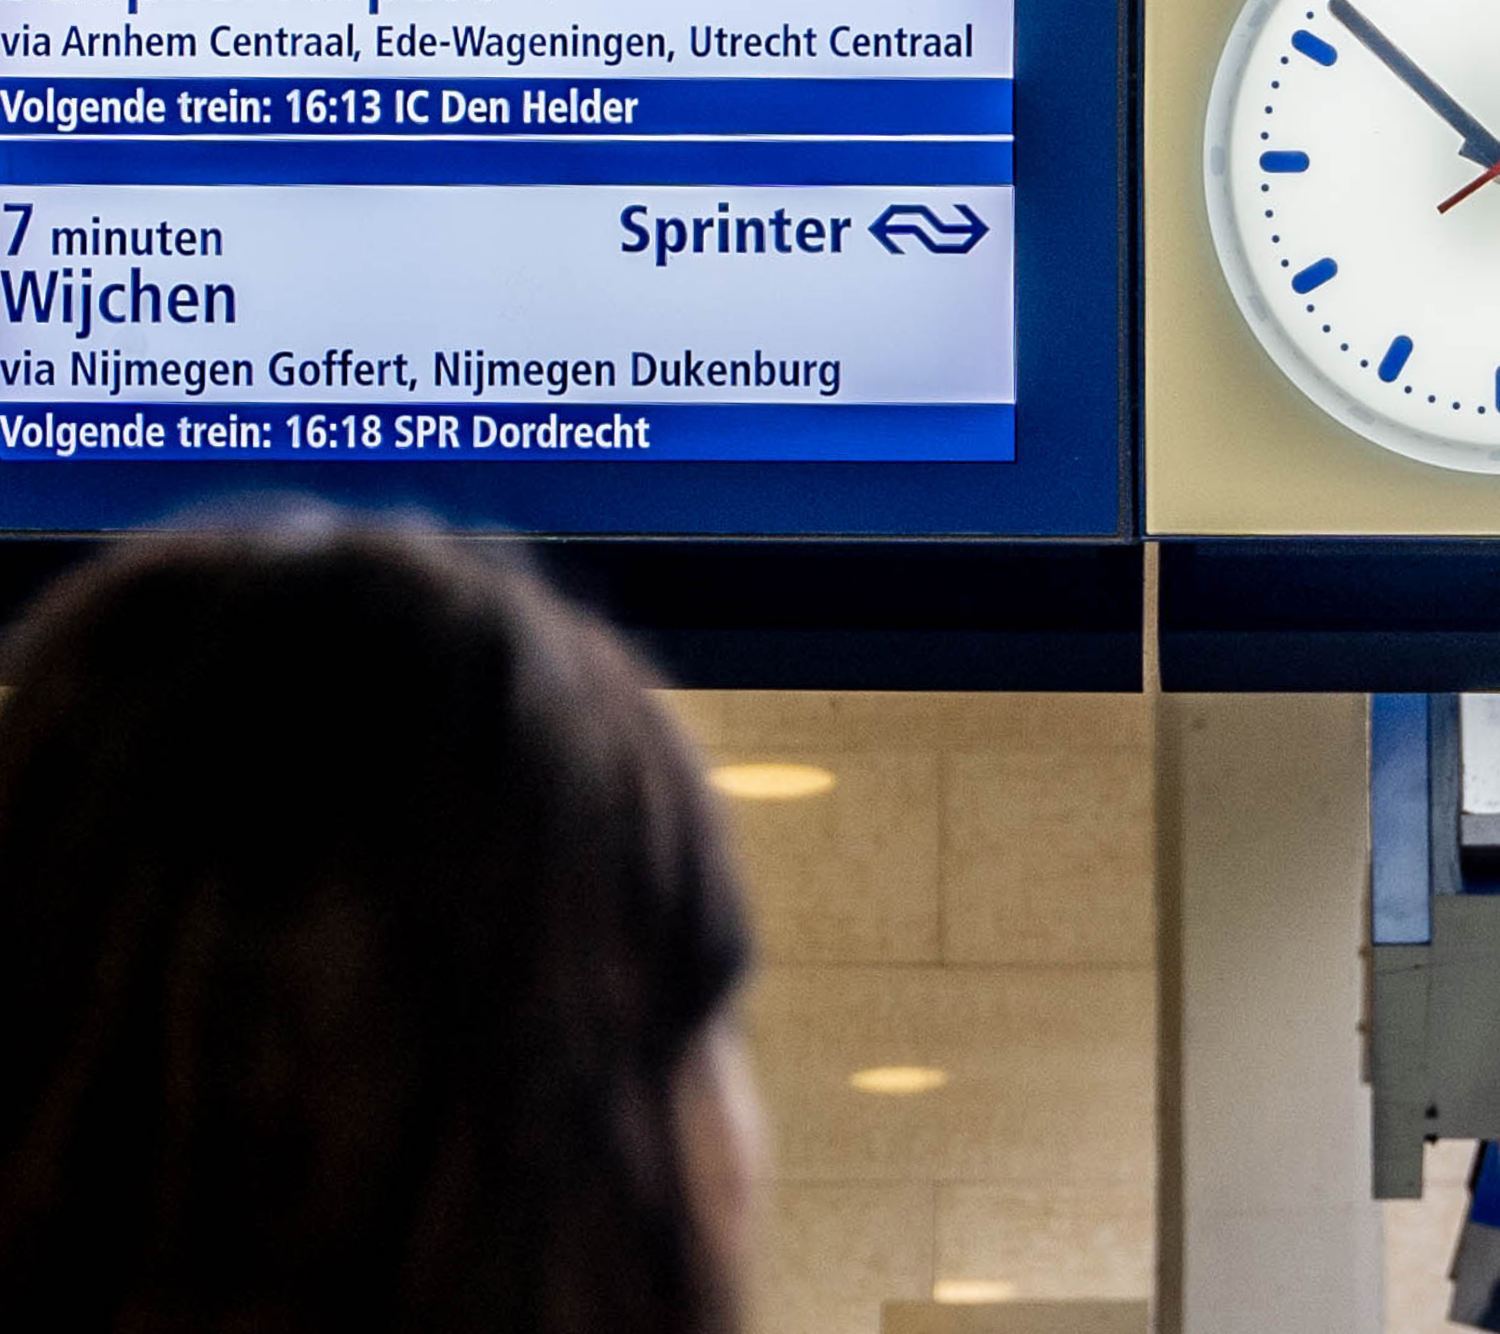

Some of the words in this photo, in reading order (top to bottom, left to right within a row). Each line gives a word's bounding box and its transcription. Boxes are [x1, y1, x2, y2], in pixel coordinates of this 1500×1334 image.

[1, 25, 51, 57] via
[62, 25, 196, 57] Arnhem
[210, 25, 361, 62] Centraal,
[376, 25, 675, 65] Ede-Wageningen,
[690, 25, 818, 58] Utrecht
[830, 25, 973, 58] Centraal
[0, 87, 166, 131] Volgende
[177, 89, 272, 124] trein:
[286, 90, 382, 124] 16:13
[396, 90, 430, 125] IC
[441, 90, 509, 125] Den
[523, 89, 639, 125] Helder
[3, 203, 34, 256] 7
[51, 217, 223, 256] minuten
[620, 202, 852, 267] Sprinter
[1, 267, 237, 339] Wijchen
[0, 351, 55, 386] via
[70, 351, 253, 396] Nijmegen
[268, 350, 418, 391] Goffert,
[434, 351, 615, 396] Nijmegen
[631, 350, 842, 397] Dukenburg
[177, 414, 272, 449] trein:
[286, 415, 383, 449] 16:18
[395, 415, 460, 449] SPR
[473, 413, 650, 449] Dordrecht
